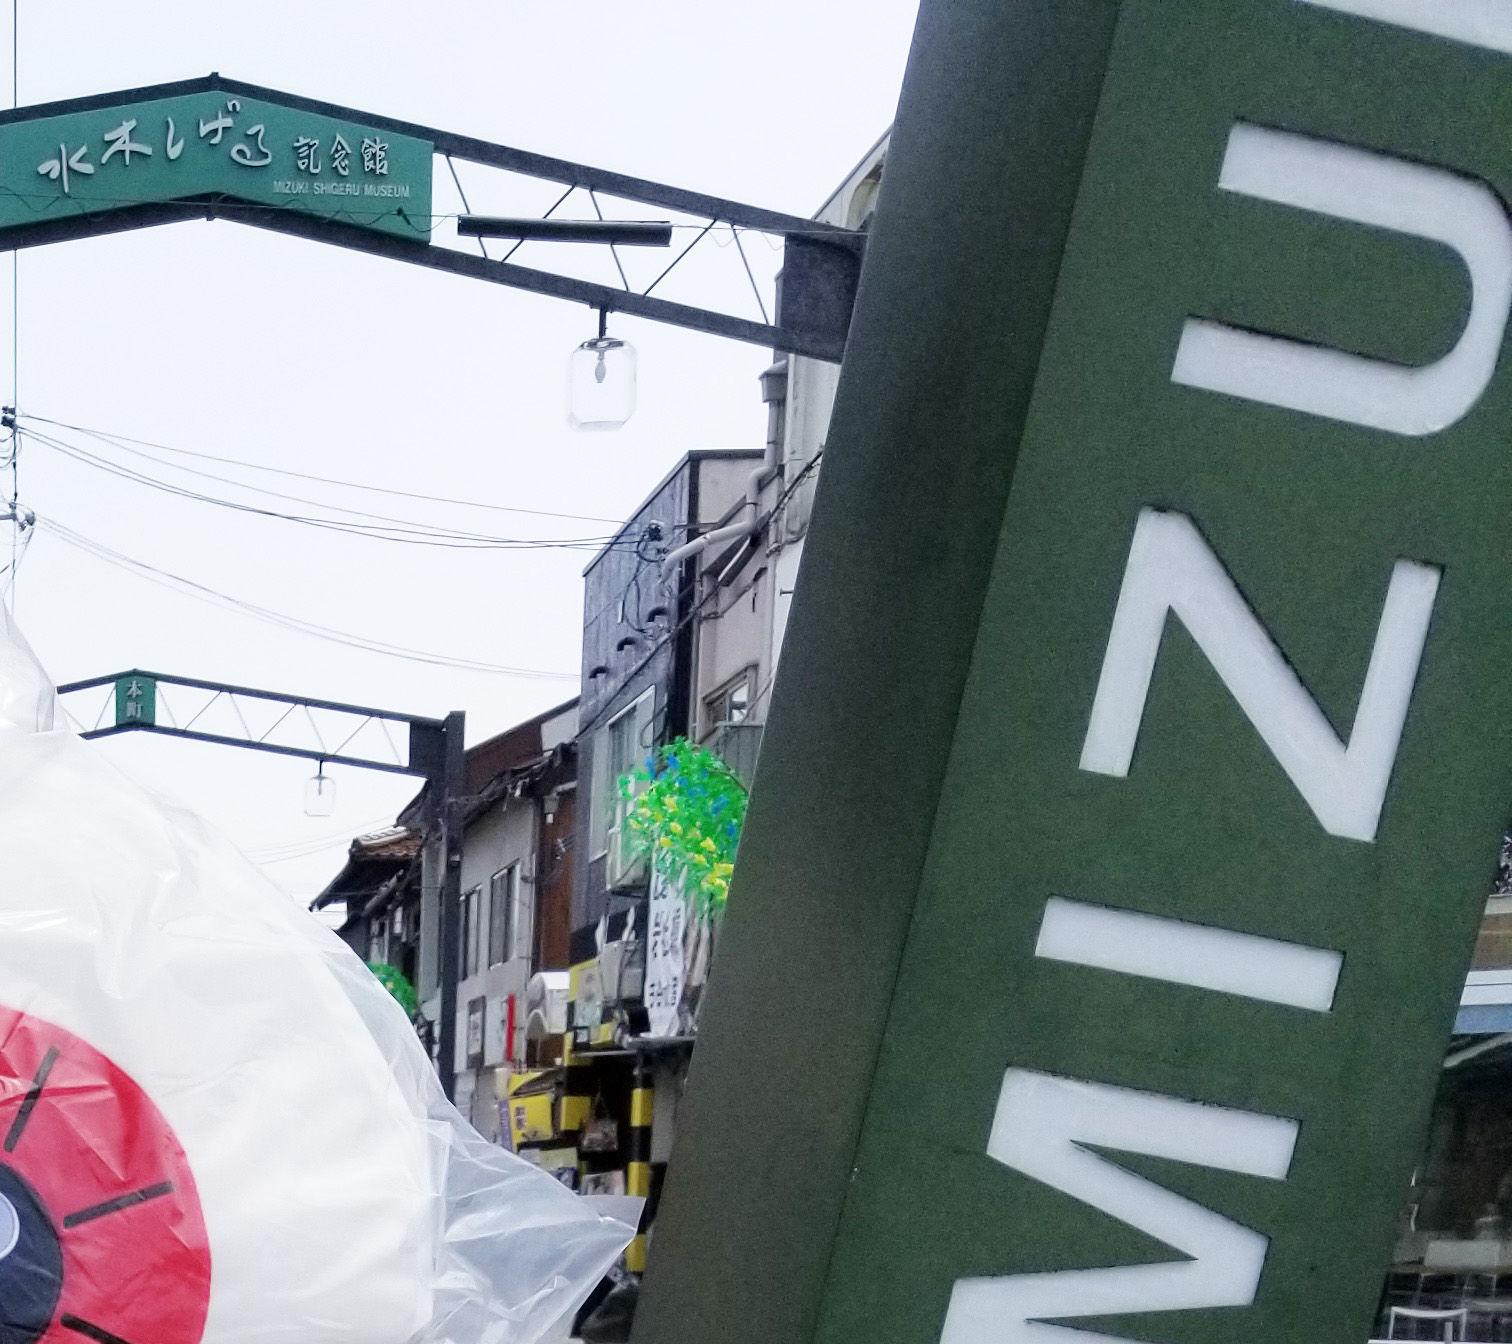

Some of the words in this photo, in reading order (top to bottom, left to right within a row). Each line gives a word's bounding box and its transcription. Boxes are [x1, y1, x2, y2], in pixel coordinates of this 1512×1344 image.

[36, 99, 389, 194] 水木しげる記念館
[273, 180, 309, 194] MIZUKI
[313, 182, 360, 196] SHIGERU
[363, 184, 411, 198] MUSEUM
